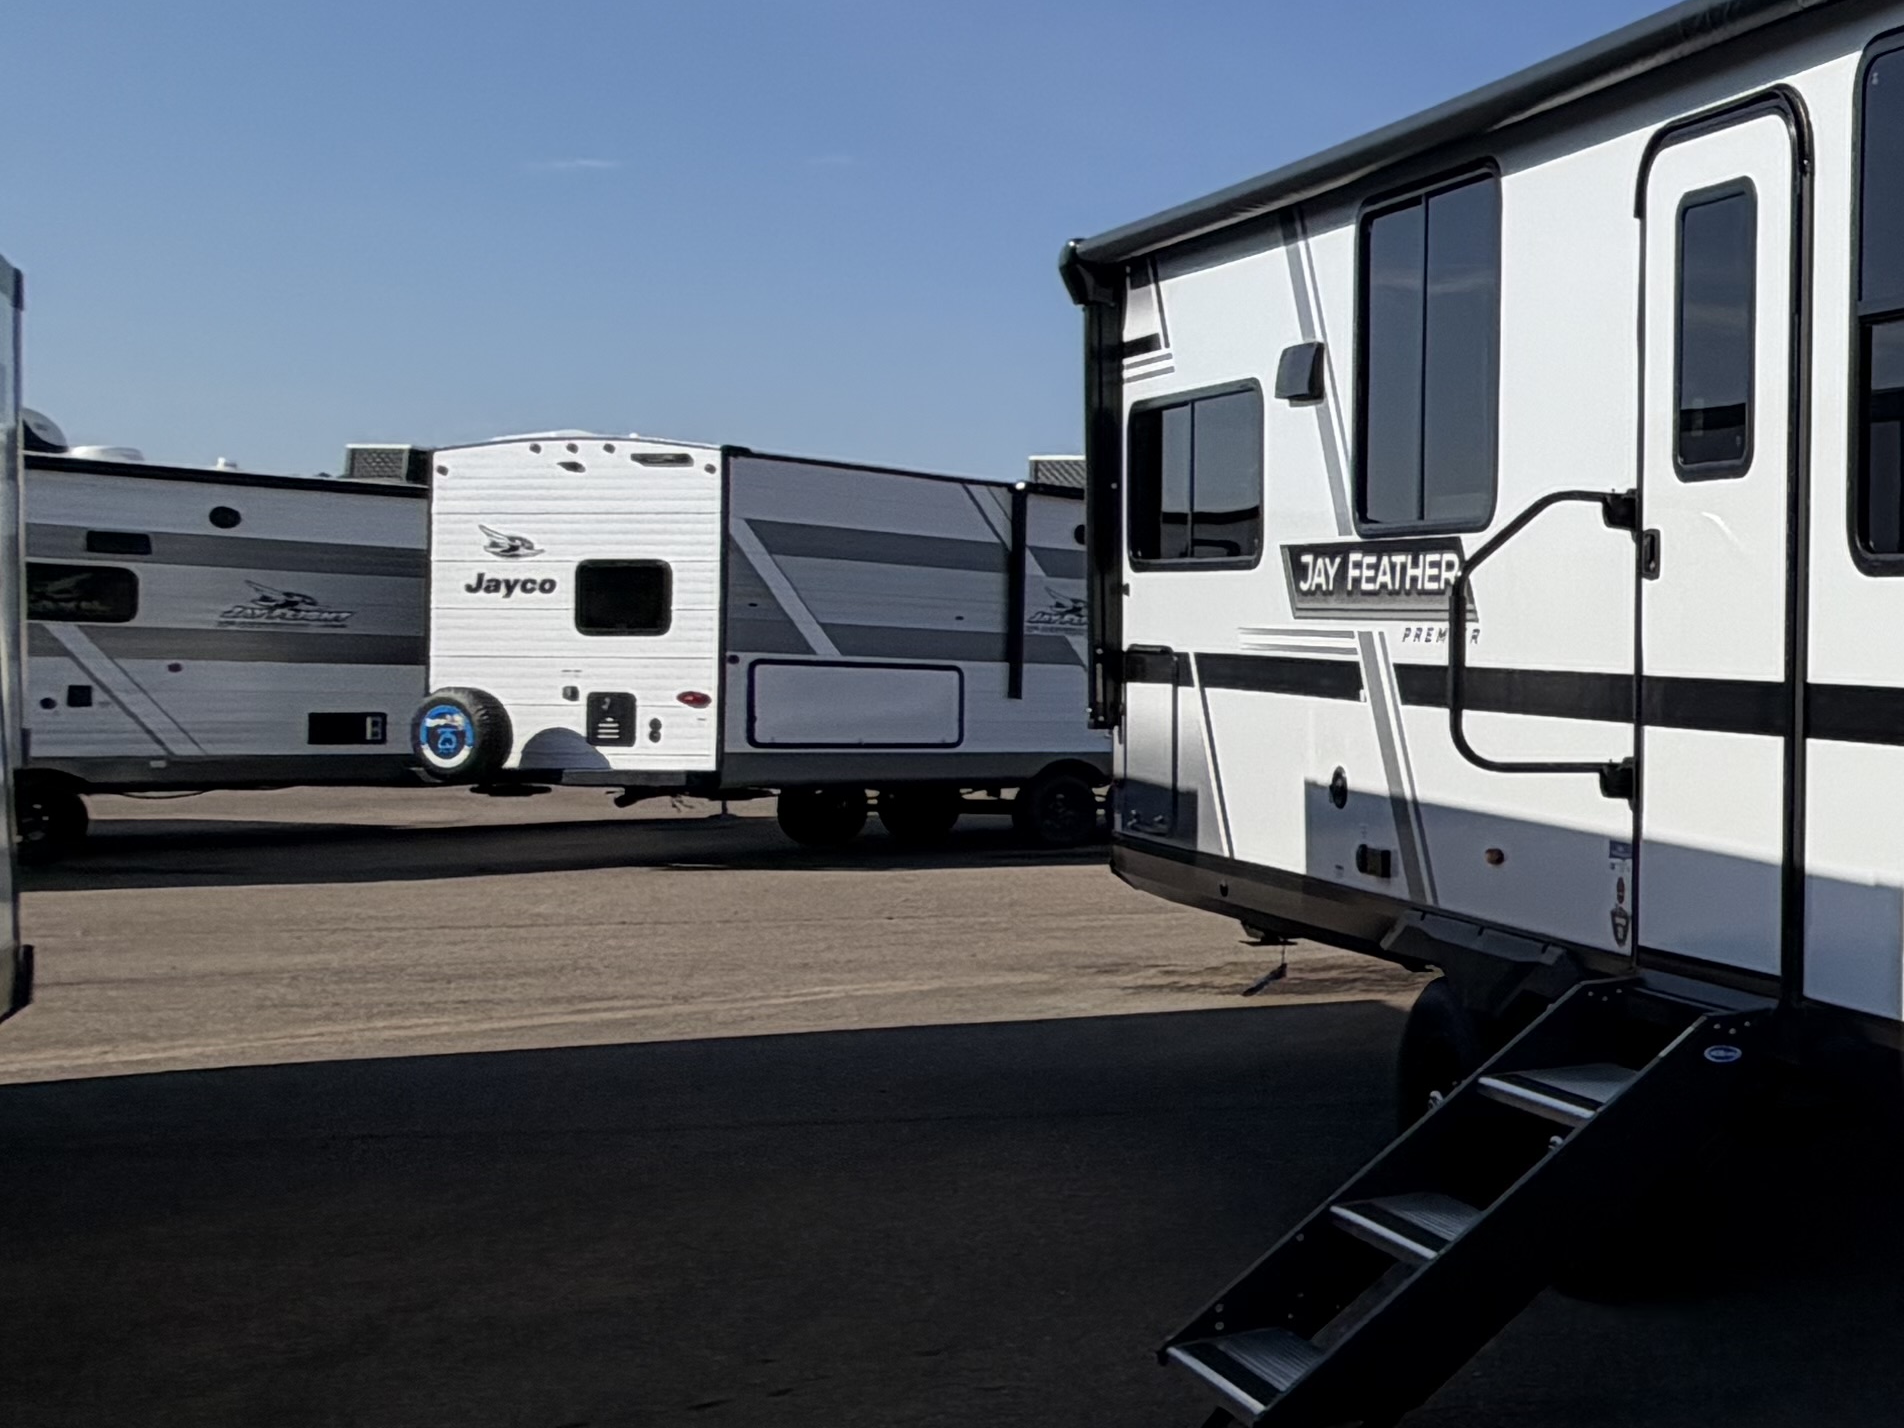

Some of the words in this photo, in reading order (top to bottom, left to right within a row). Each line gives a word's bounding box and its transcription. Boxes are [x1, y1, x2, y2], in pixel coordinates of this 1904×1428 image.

[1300, 554, 1343, 591] JAY
[1347, 552, 1461, 591] FEATHER
[465, 573, 557, 599] Jayco
[1402, 627, 1481, 645] PREMR
